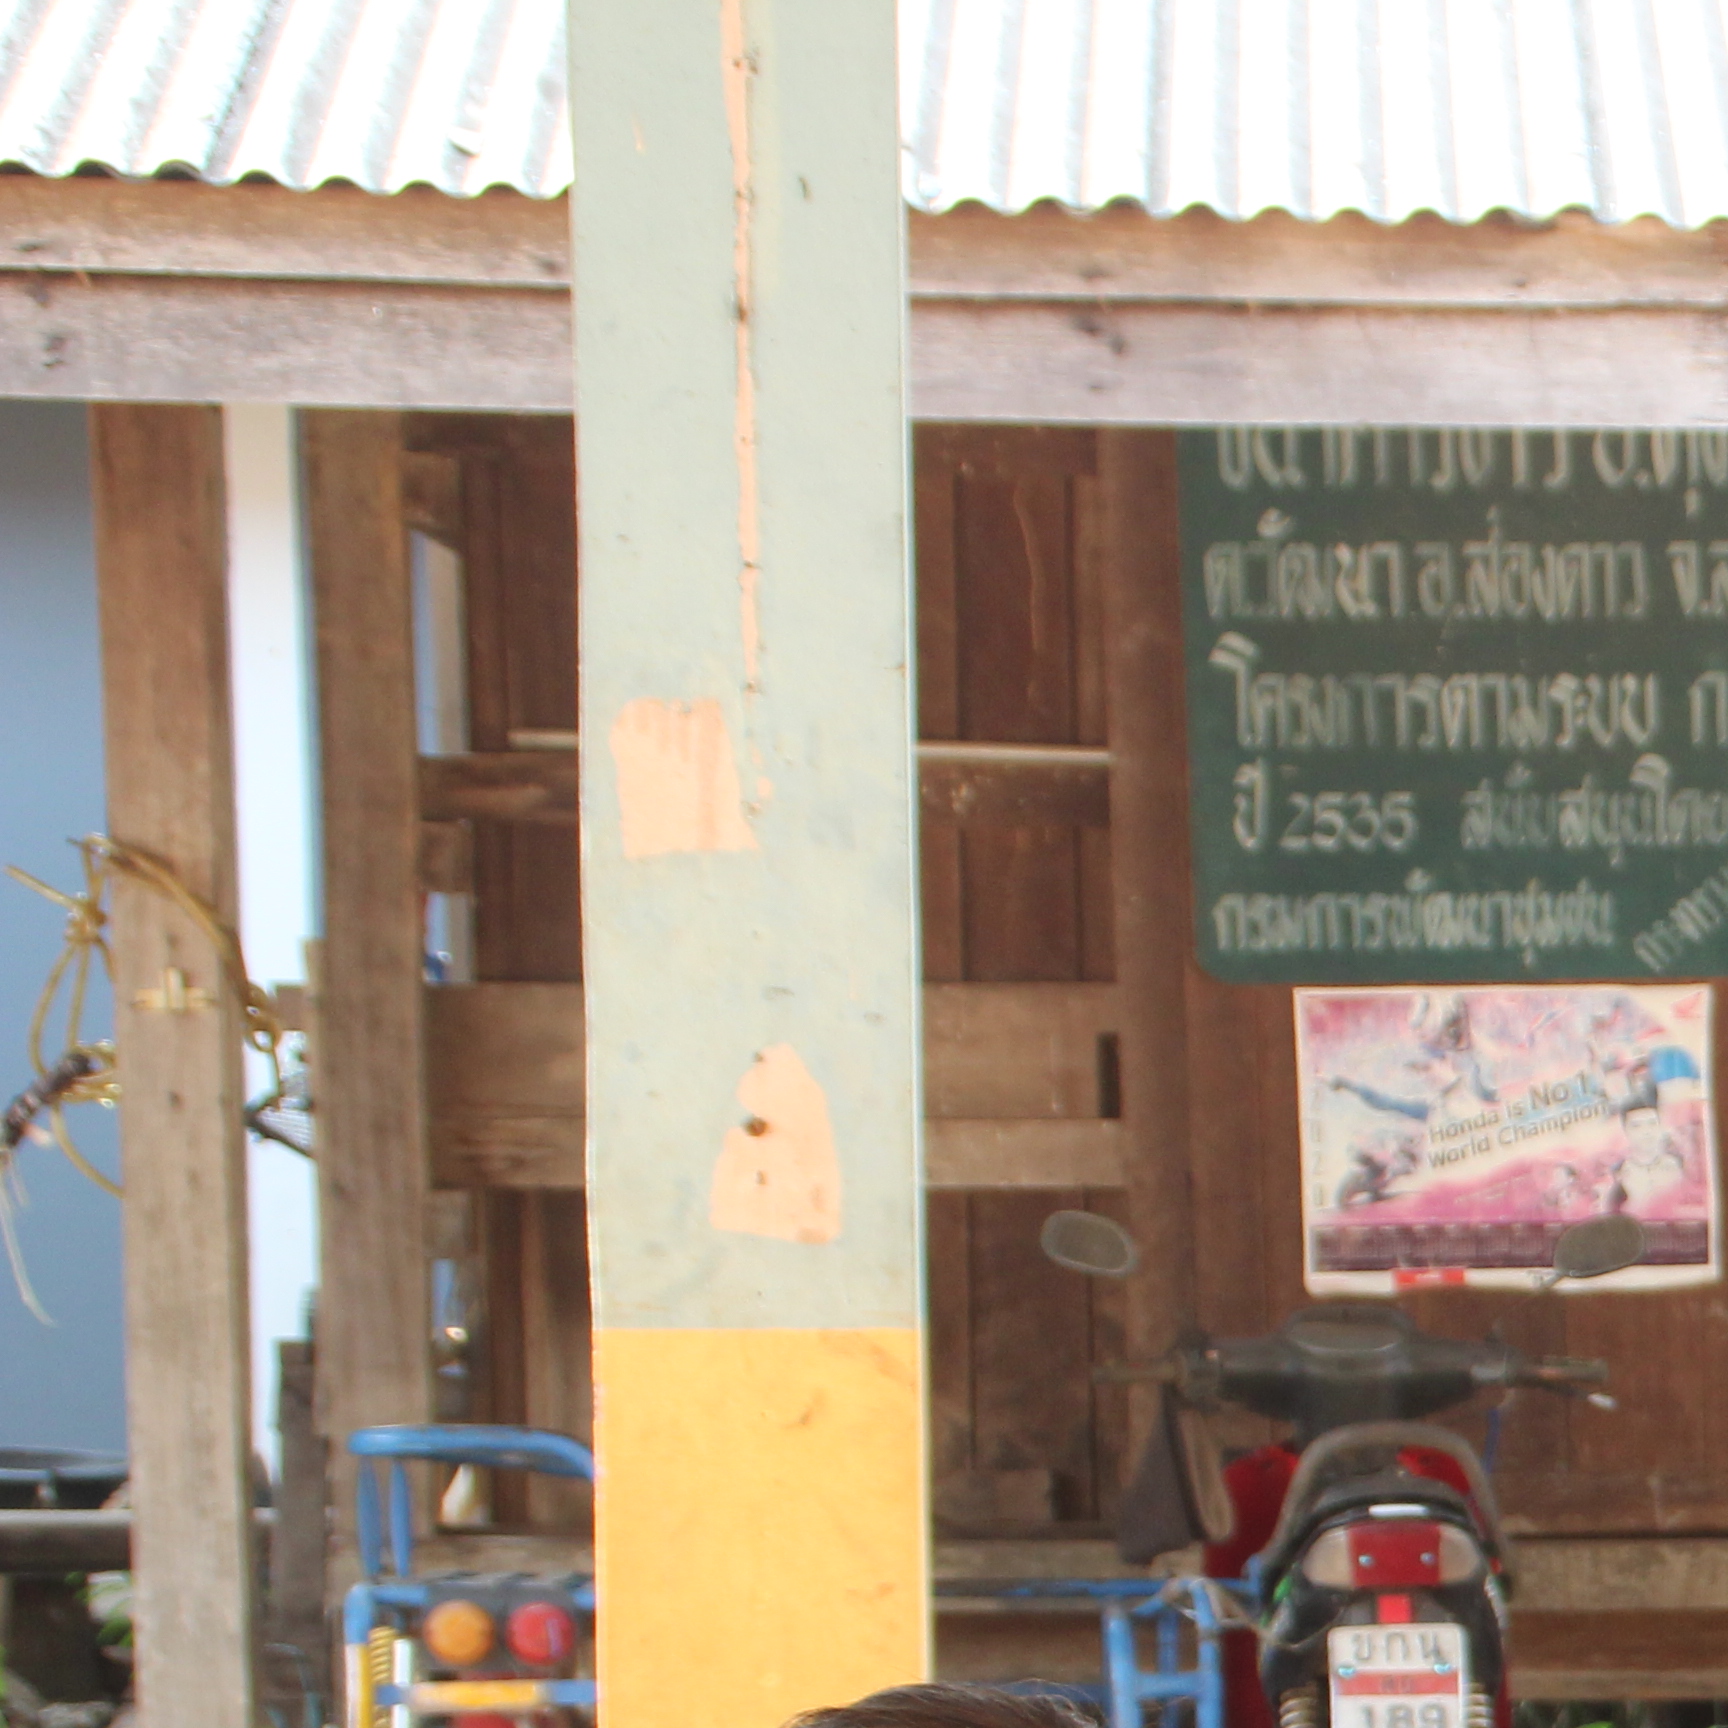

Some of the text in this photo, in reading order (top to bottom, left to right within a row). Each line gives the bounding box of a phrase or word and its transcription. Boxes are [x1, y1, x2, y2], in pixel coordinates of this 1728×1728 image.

[1232, 756, 1270, 852] ปี
[1278, 790, 1420, 853] 2535
[1428, 1110, 1502, 1145] Honda
[1506, 1099, 1526, 1119] is
[1528, 1080, 1571, 1111] No
[1427, 1135, 1491, 1170] World
